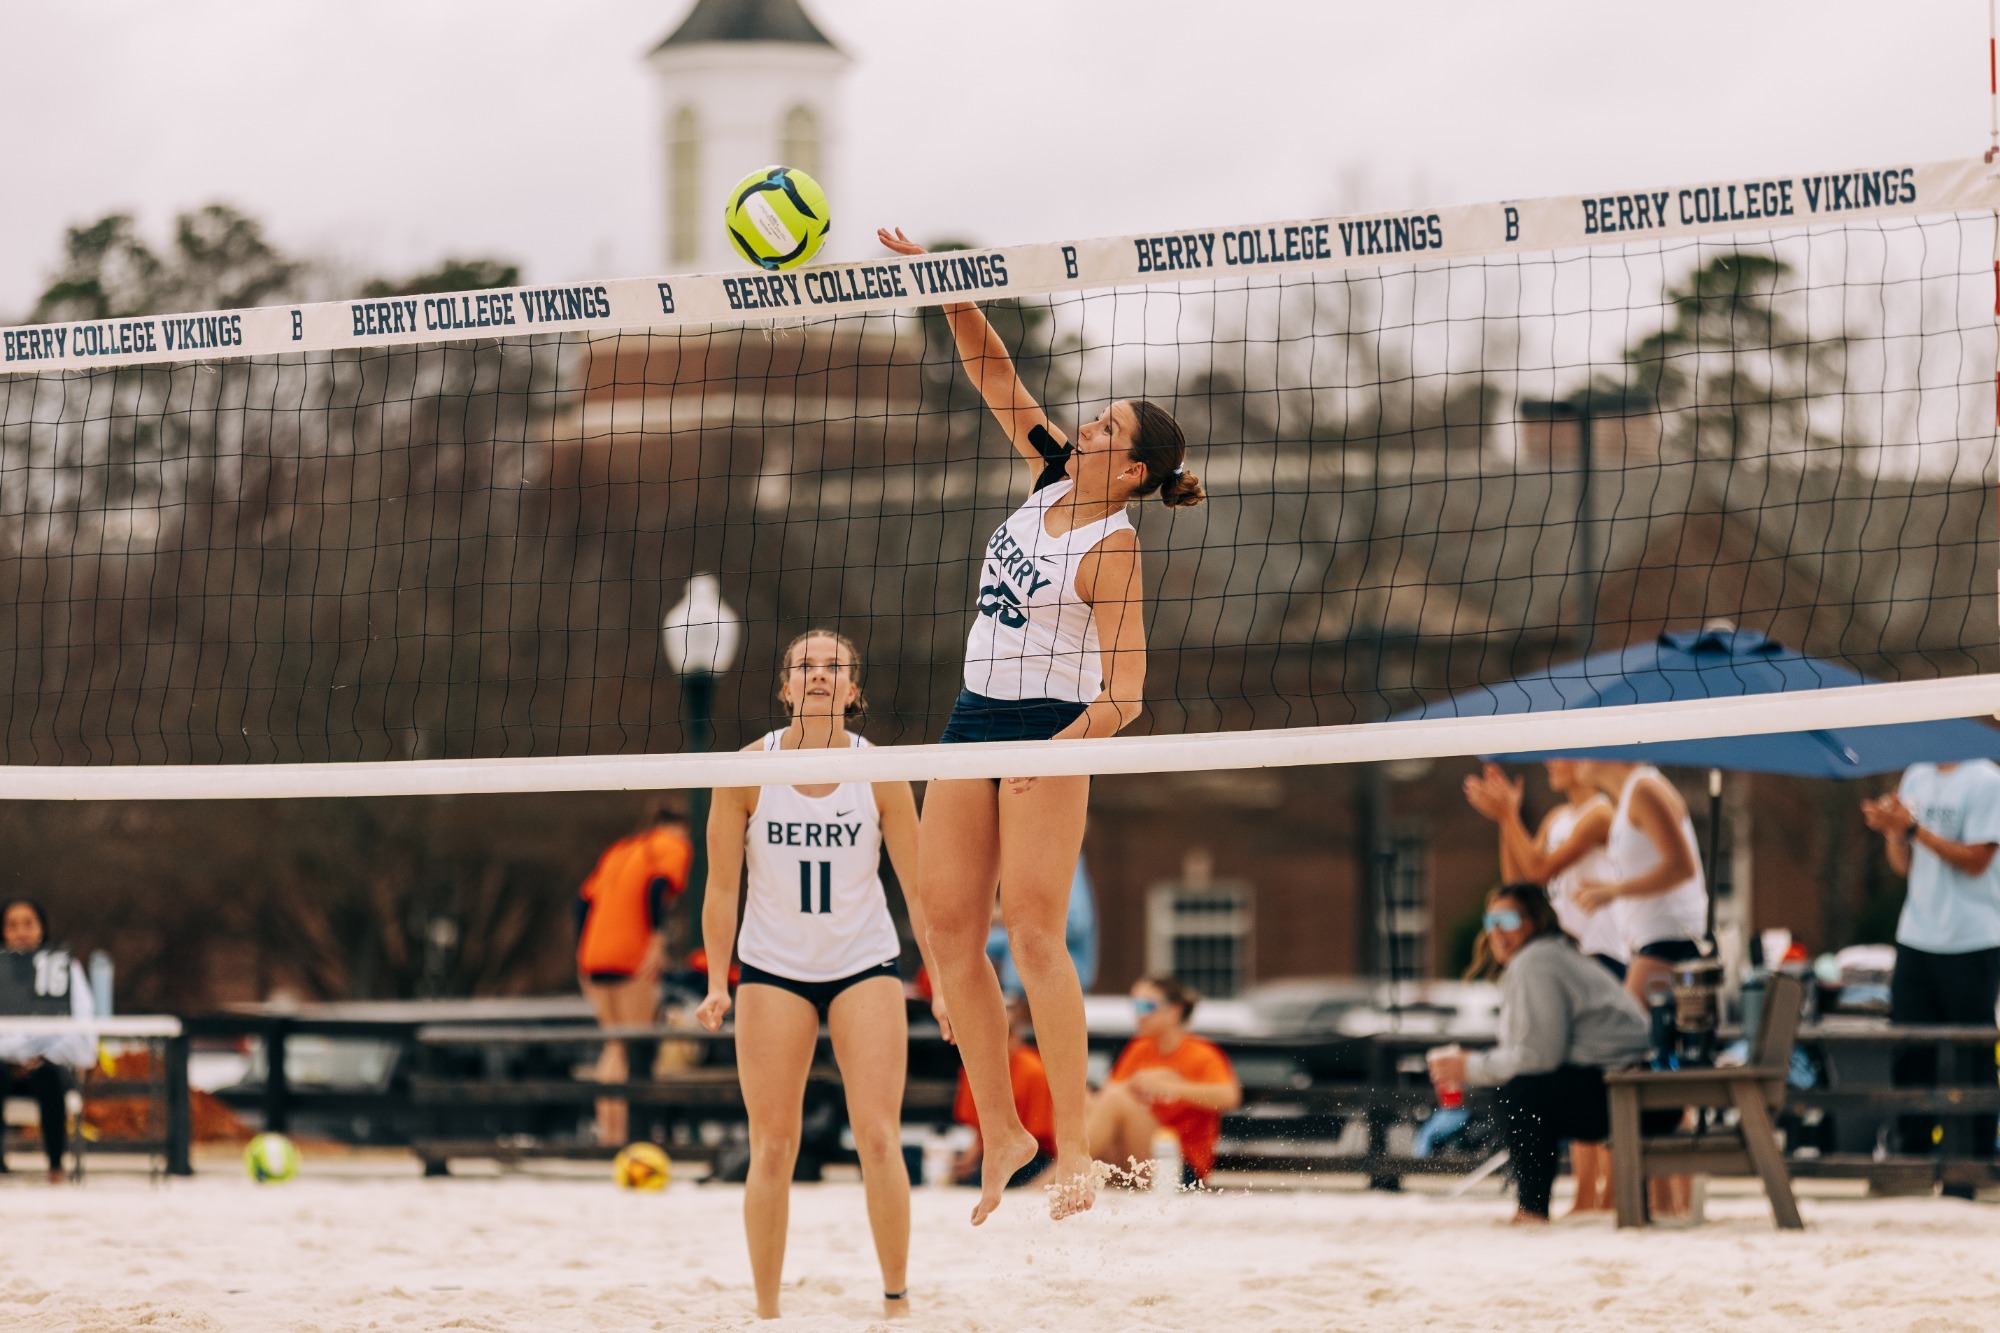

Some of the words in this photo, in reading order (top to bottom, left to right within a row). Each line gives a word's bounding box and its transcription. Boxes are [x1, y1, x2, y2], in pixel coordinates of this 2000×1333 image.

[1504, 207, 1520, 242] B
[1582, 192, 1670, 235] BERRY
[1678, 180, 1794, 226] COLLEGE
[1801, 168, 1917, 213] VIKINGS
[1060, 246, 1079, 280] B
[1133, 233, 1216, 273] BERRY
[1222, 225, 1332, 266] COLLEGE
[1338, 214, 1443, 257] VIKINGS
[657, 283, 675, 314] B
[722, 274, 802, 310] BERRY
[803, 265, 908, 305] COLLEGE
[908, 254, 1009, 295] VIKINGS
[290, 310, 303, 341] B
[351, 301, 418, 337] BERRY
[423, 293, 516, 331] COLLEGE
[519, 287, 611, 324] VIKINGS
[4, 328, 68, 363] BERRY
[72, 321, 157, 357] COLLEGE
[161, 314, 243, 352] VIKINGS
[989, 525, 1052, 598] BERRY
[767, 821, 862, 847] BERRY
[799, 860, 832, 914] 11
